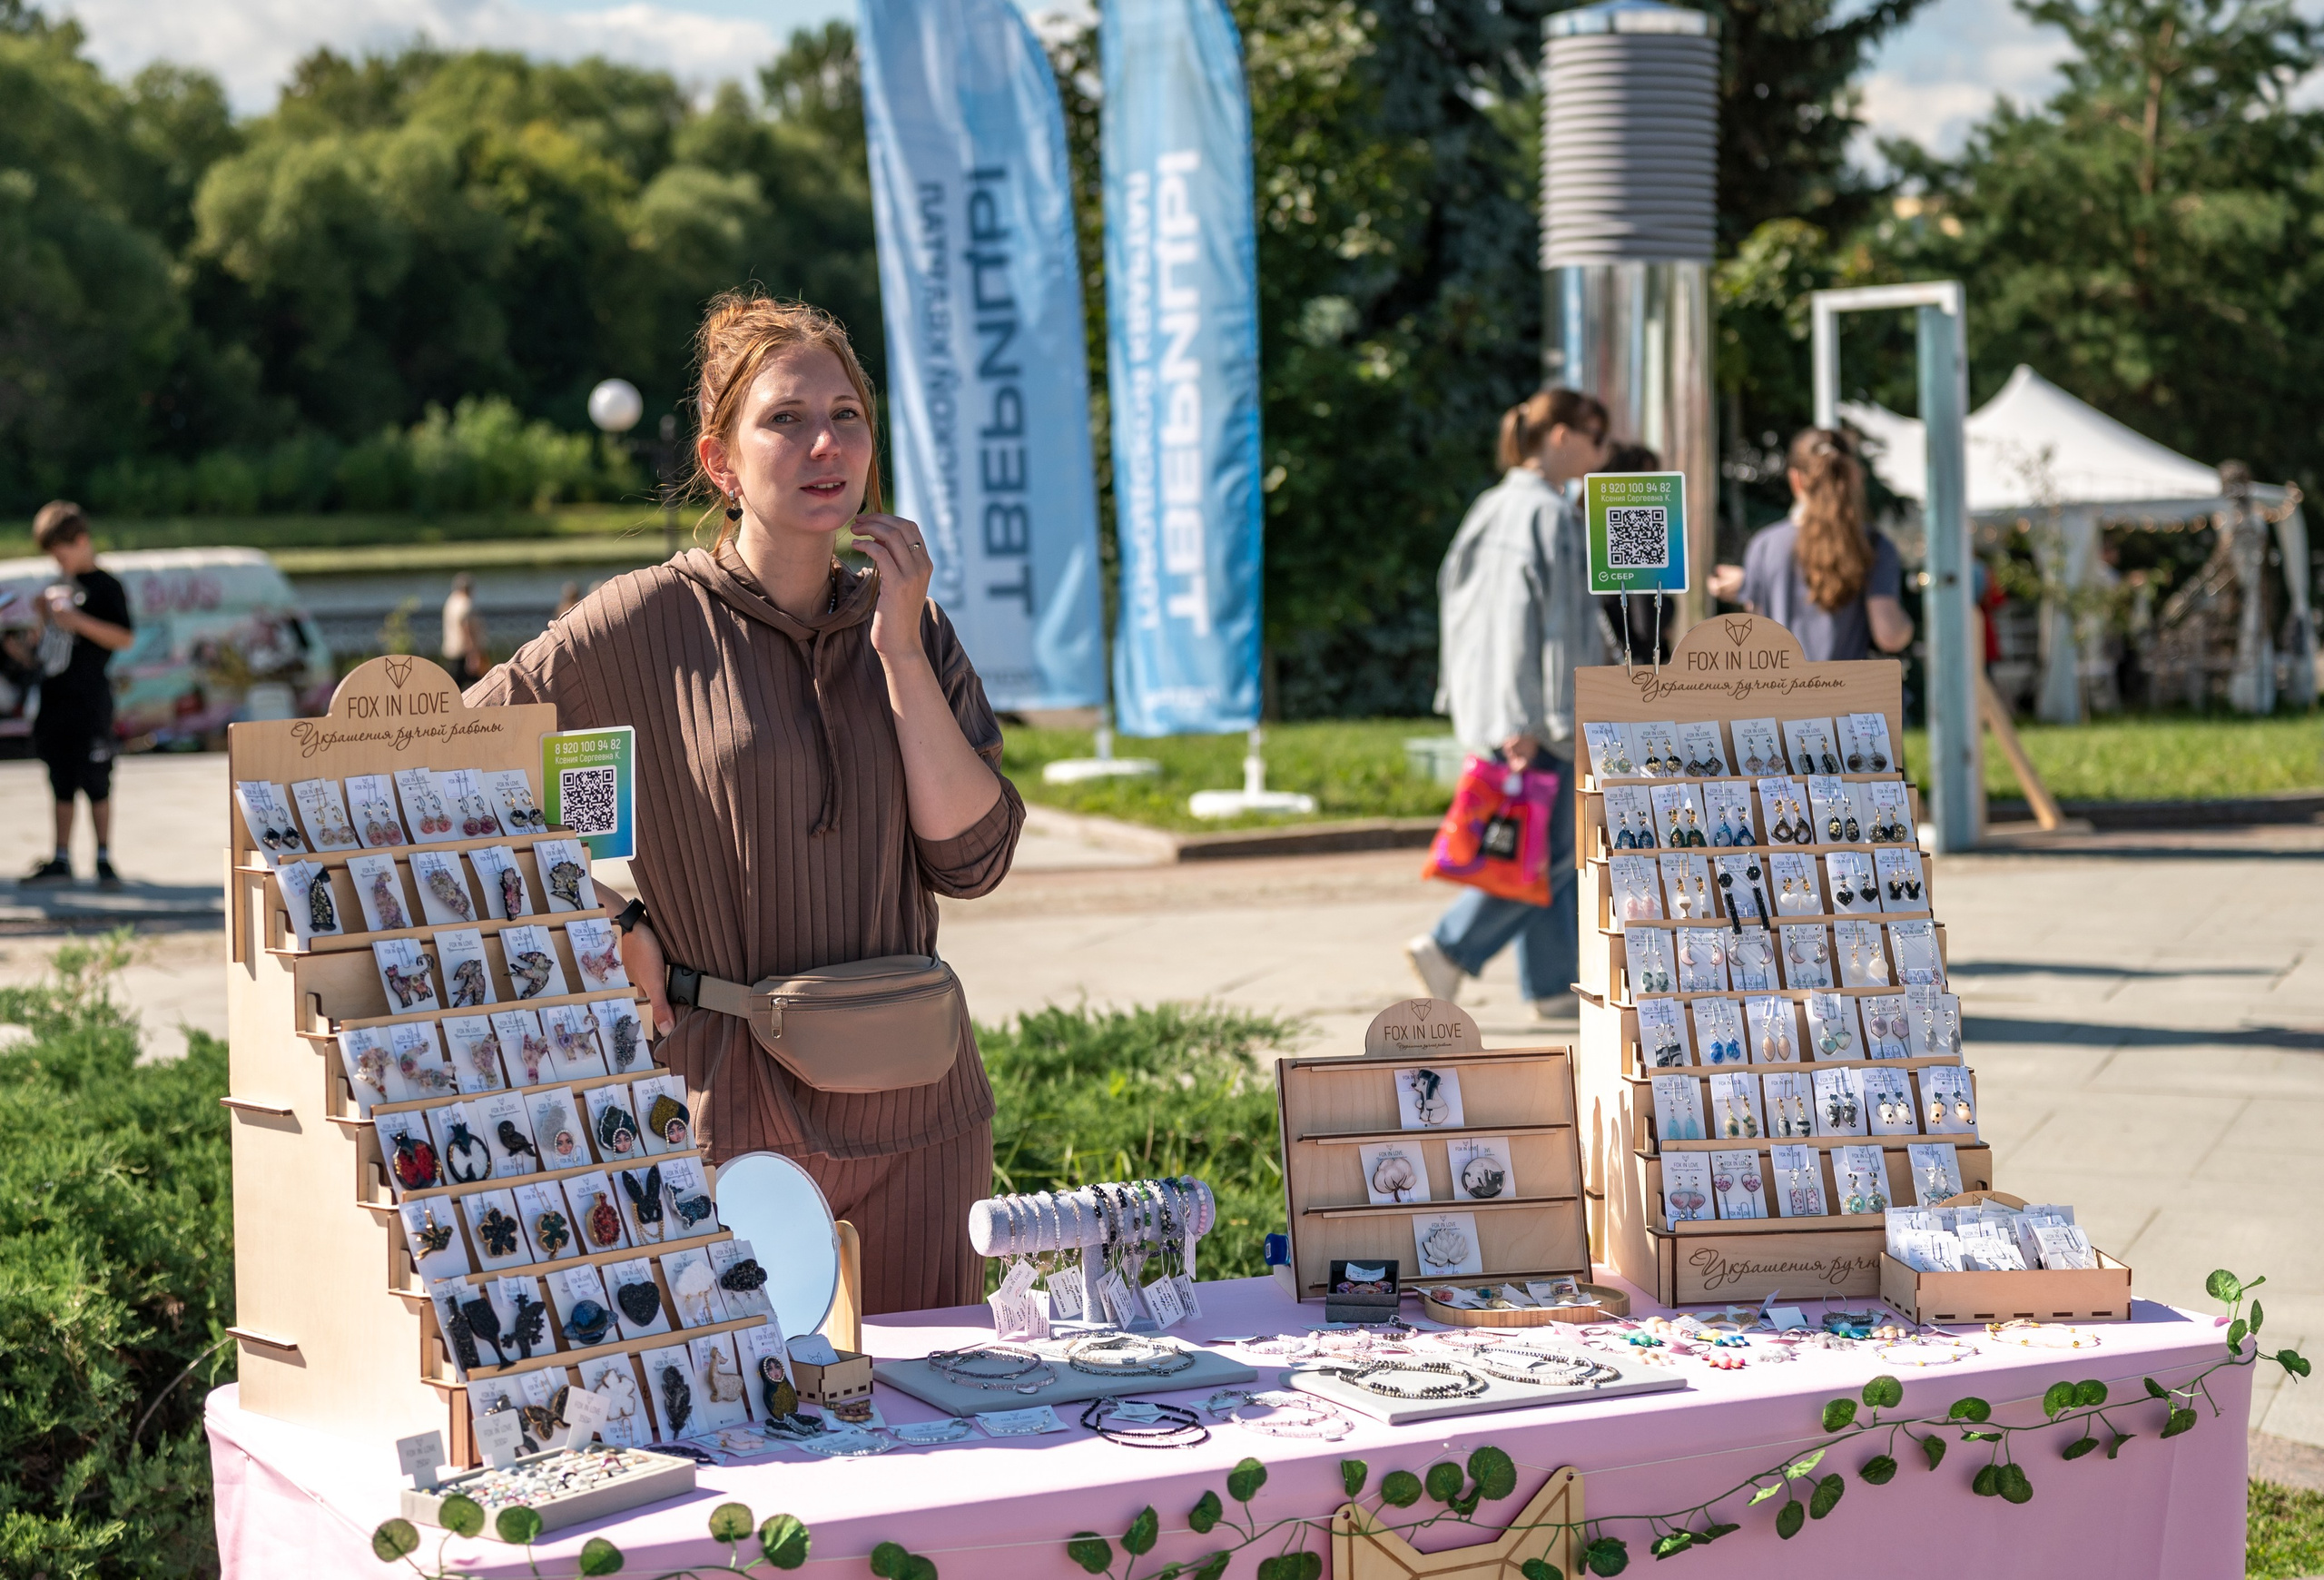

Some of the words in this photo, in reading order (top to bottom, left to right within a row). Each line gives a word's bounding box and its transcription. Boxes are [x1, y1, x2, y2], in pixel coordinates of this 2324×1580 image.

[1600, 483, 1606, 493] 8
[1609, 483, 1625, 493] 920
[1628, 482, 1644, 493] 100
[1646, 482, 1657, 493] 94
[1660, 482, 1671, 493] 82
[1627, 494, 1663, 503] Сергеевна
[1688, 652, 1719, 671] FOX
[1726, 651, 1741, 670] IN
[1749, 650, 1789, 669] LOVE
[1632, 671, 1732, 703] Украшения
[1728, 678, 1787, 700] ручной
[1782, 675, 1846, 695] работы
[348, 696, 379, 719] FOX
[386, 694, 402, 717] IN
[409, 692, 449, 715] LOVE
[290, 721, 394, 758] Украшения
[388, 724, 447, 751] ручной
[442, 719, 503, 743] работы
[555, 743, 560, 755] 8
[563, 742, 578, 754] 920
[581, 741, 595, 752] 100
[598, 740, 608, 751] 94
[610, 738, 621, 750] 82
[555, 756, 578, 765] Ксения
[580, 753, 613, 763] Сергеевна
[615, 751, 621, 759] К.
[1384, 1025, 1408, 1041] FOX
[1413, 1025, 1426, 1040] IN
[1431, 1023, 1462, 1039] LOVE
[1689, 1248, 1827, 1290] Украшения
